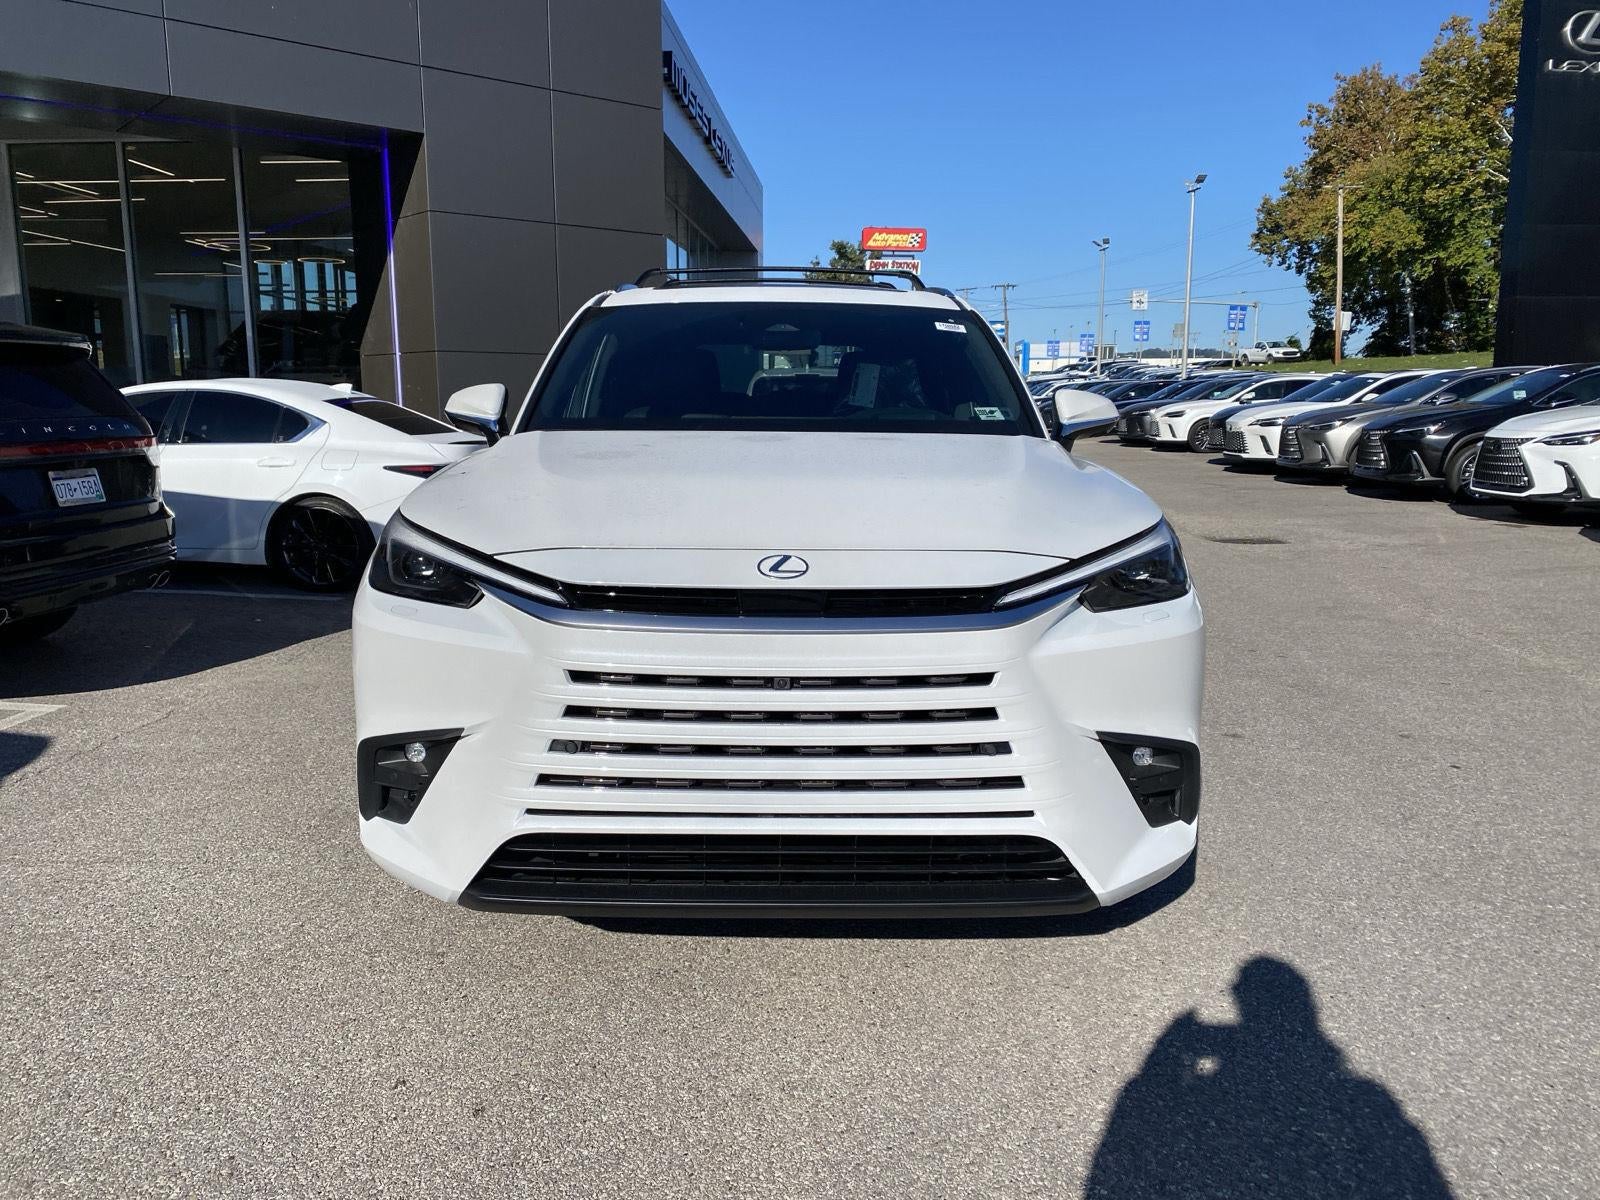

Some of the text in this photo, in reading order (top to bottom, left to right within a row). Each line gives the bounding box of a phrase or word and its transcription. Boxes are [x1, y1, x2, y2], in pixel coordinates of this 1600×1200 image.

[1549, 59, 1600, 73] LEX
[872, 232, 909, 241] Advance
[886, 240, 908, 248] Parts
[0, 423, 130, 436] INCOLN
